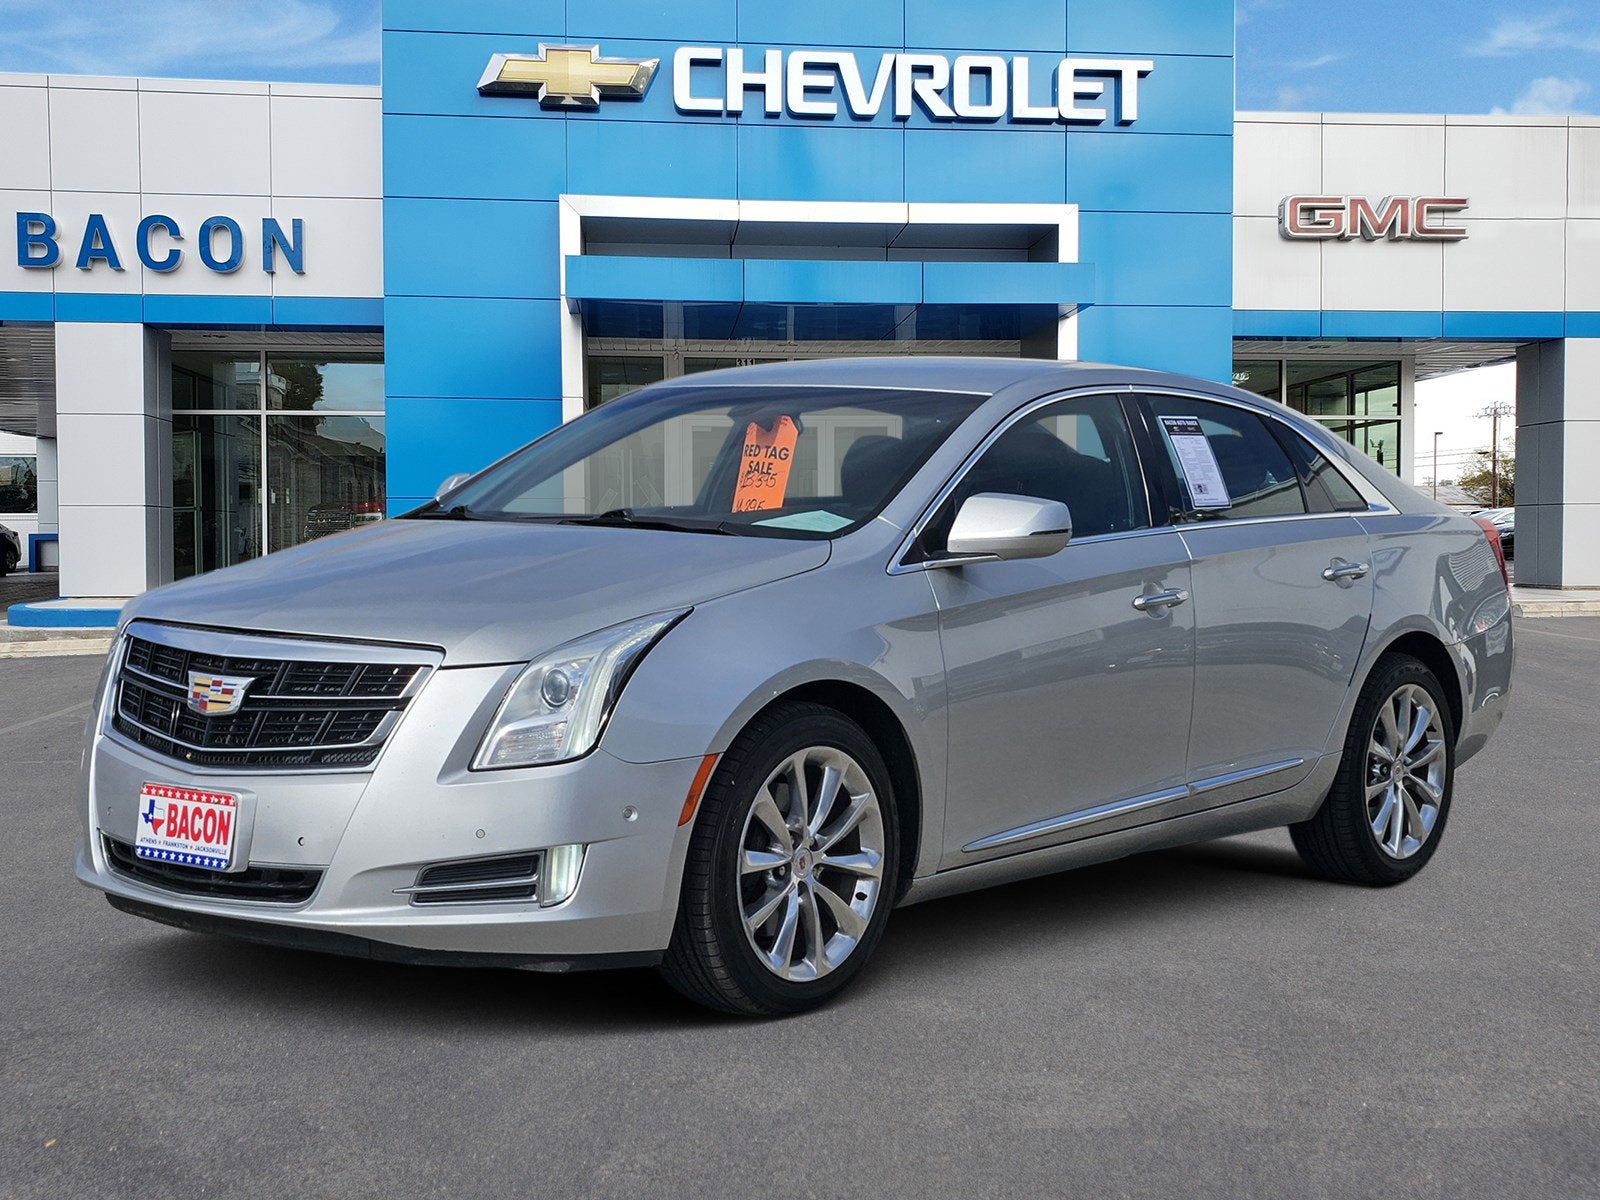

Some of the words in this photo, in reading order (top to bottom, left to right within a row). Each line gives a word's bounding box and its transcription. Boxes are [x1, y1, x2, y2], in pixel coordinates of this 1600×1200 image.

[673, 46, 1154, 124] CHEVROLET
[1279, 194, 1469, 241] GMC
[16, 211, 304, 274] BACON
[744, 444, 761, 457] RED
[764, 446, 789, 460] TAG
[748, 461, 773, 475] SALE
[166, 803, 231, 845] BACON
[140, 836, 157, 845] ATHENS
[162, 840, 188, 849] FRANKSTON
[194, 845, 227, 855] JACKSONVILLE
